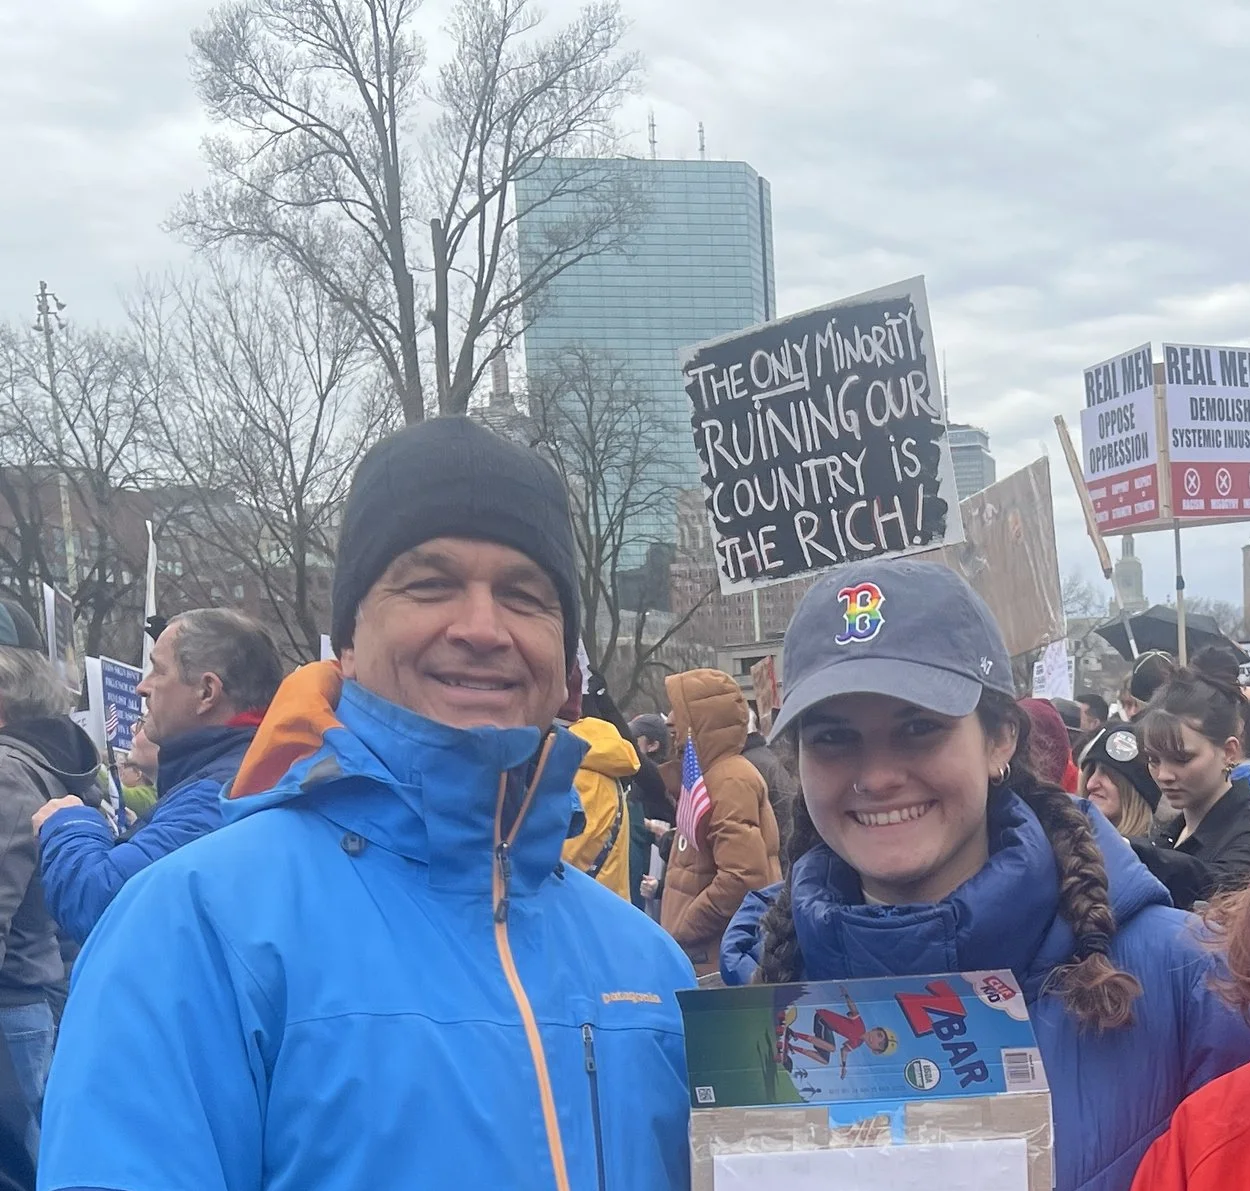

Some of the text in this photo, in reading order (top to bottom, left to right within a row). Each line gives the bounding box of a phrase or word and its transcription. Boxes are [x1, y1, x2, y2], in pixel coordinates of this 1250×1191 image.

[688, 306, 917, 410] THE ONLY MINORITY
[1085, 348, 1153, 408] REAL MEN
[1165, 346, 1217, 386] REAL
[702, 370, 943, 478] RUINING OUR
[1098, 403, 1136, 440] OPPOSE
[1190, 397, 1250, 423] DEMOLISH
[1089, 431, 1149, 474] OPPRESSION
[1172, 429, 1221, 449] SYSTEMIC
[713, 448, 866, 523] COUNTRY
[719, 526, 784, 578] THE
[835, 582, 886, 645] B
